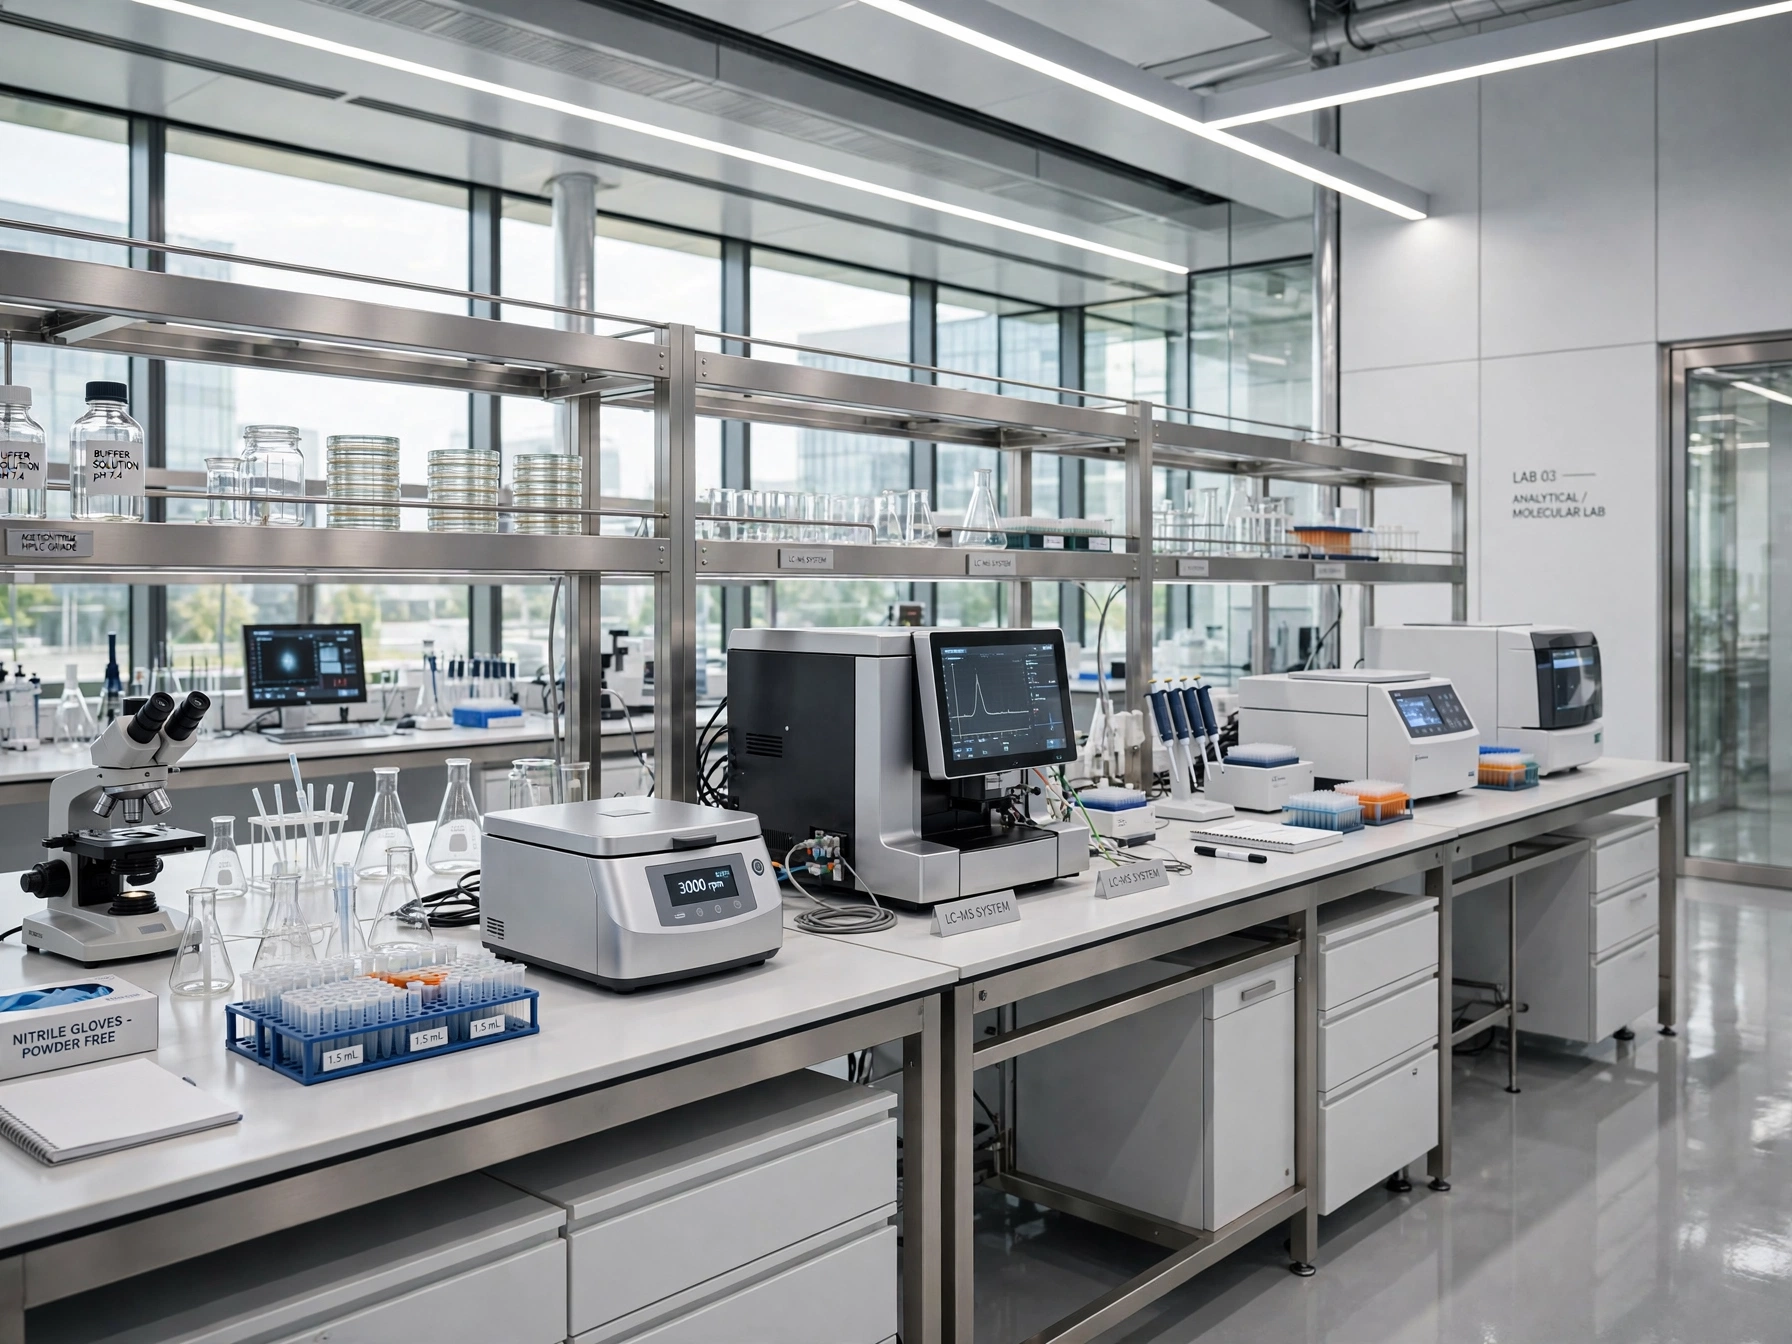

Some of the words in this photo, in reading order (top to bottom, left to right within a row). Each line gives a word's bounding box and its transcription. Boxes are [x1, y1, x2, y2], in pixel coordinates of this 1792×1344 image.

[0, 451, 31, 461] UFFER
[94, 449, 131, 459] BUFFER
[92, 459, 139, 471] SOLUTION
[93, 471, 106, 482] pH
[1513, 470, 1538, 484] LAB
[1541, 469, 1557, 482] 03
[1513, 492, 1579, 504] ANALYTICAL
[1513, 506, 1581, 519] MOLECULAR
[1583, 506, 1606, 517] LAB
[1108, 873, 1132, 888] LC-MS
[1132, 868, 1160, 882] SYSTEM
[678, 878, 707, 895] 3000
[708, 880, 724, 892] rpm
[944, 908, 975, 925] LC-MS
[975, 900, 1011, 918] SYSTEM
[12, 1026, 67, 1046] NITRILE
[70, 1015, 123, 1035] GLOVES
[474, 1022, 487, 1033] 1.5
[488, 1018, 502, 1030] mL
[22, 1038, 81, 1059] POWDER
[84, 1031, 116, 1047] FREE
[415, 1034, 429, 1045] 1.5
[430, 1031, 444, 1042] mL
[328, 1053, 342, 1065] 1.5
[344, 1050, 359, 1061] mL
